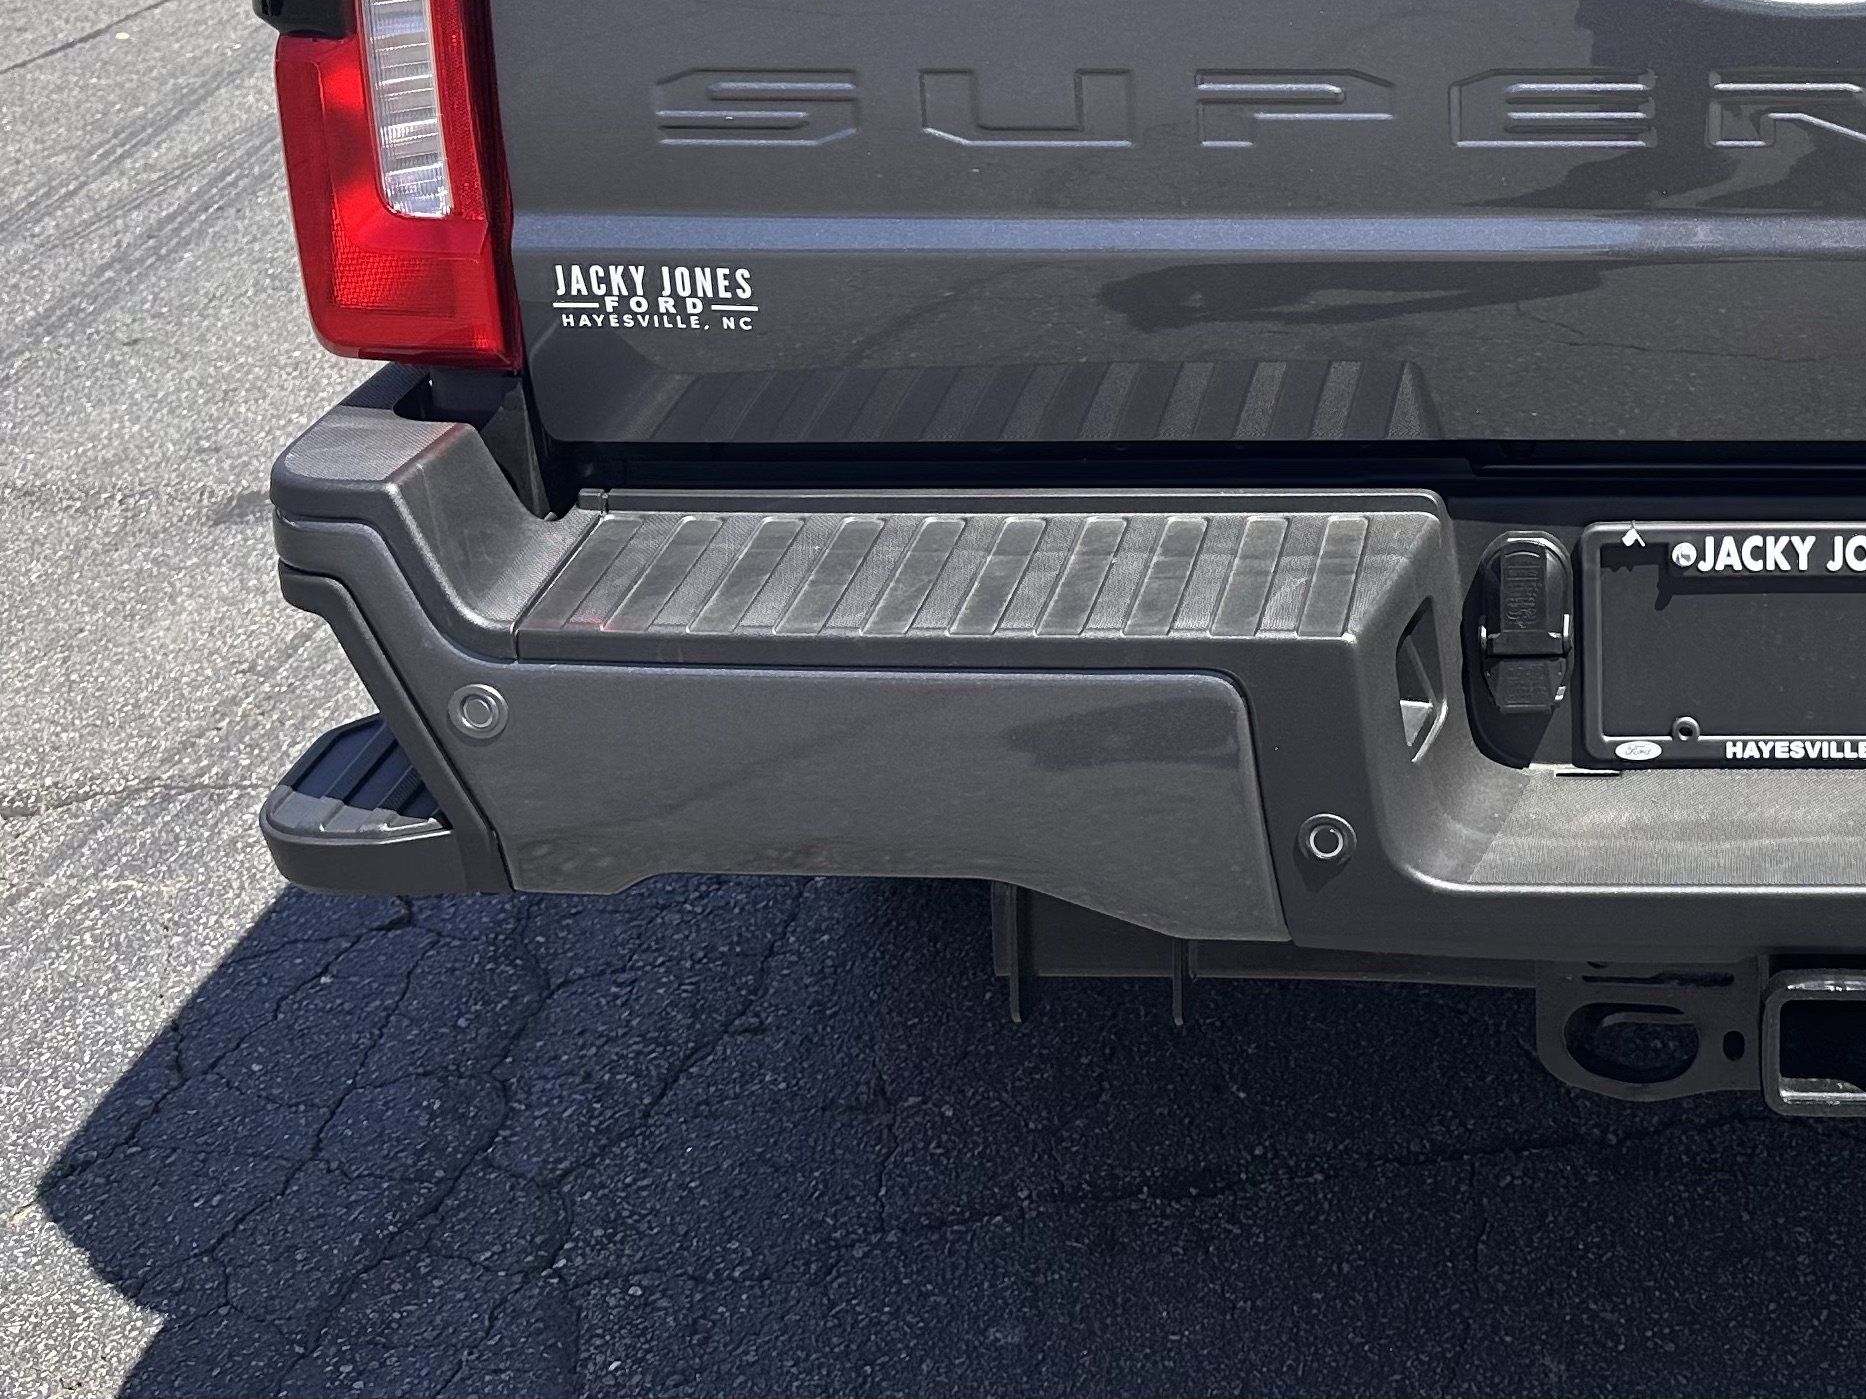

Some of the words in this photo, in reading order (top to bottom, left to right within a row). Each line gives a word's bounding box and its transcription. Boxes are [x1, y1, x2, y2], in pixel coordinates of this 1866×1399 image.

[554, 264, 646, 297] JACKY
[660, 266, 753, 300] JONES
[603, 296, 705, 315] FORD
[561, 313, 710, 331] HAYESVILLE,
[721, 316, 753, 331] NC
[1697, 535, 1816, 573] JACKY
